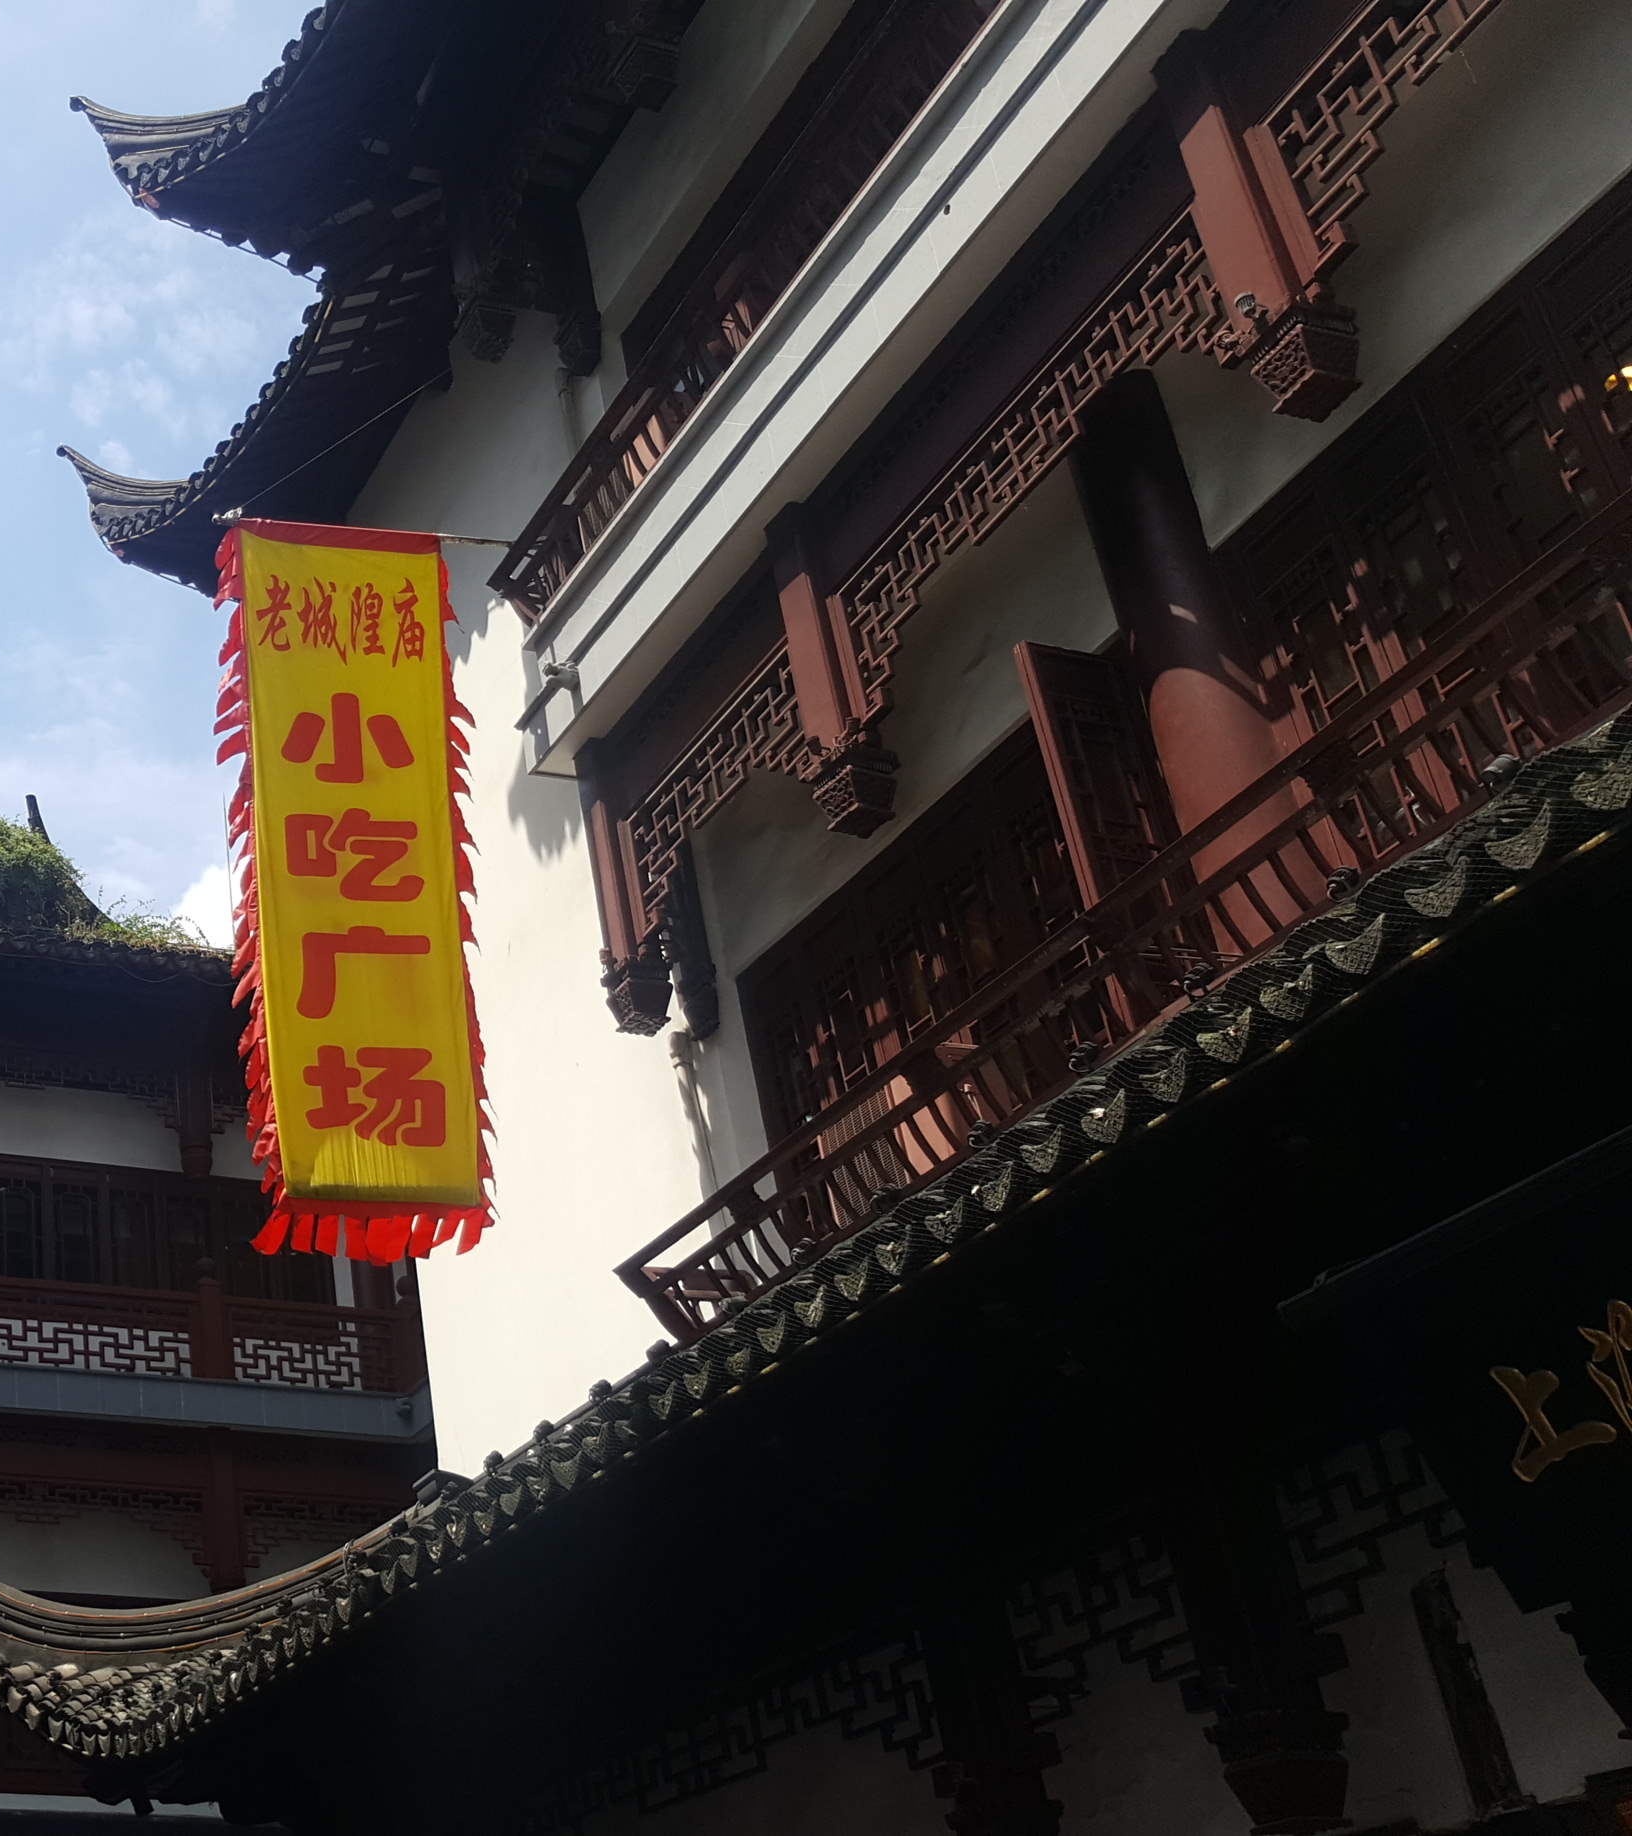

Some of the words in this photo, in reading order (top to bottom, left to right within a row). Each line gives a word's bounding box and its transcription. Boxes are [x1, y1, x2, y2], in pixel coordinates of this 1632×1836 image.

[256, 574, 427, 668] 老城隍庙
[281, 692, 447, 1148] 小吃广场
